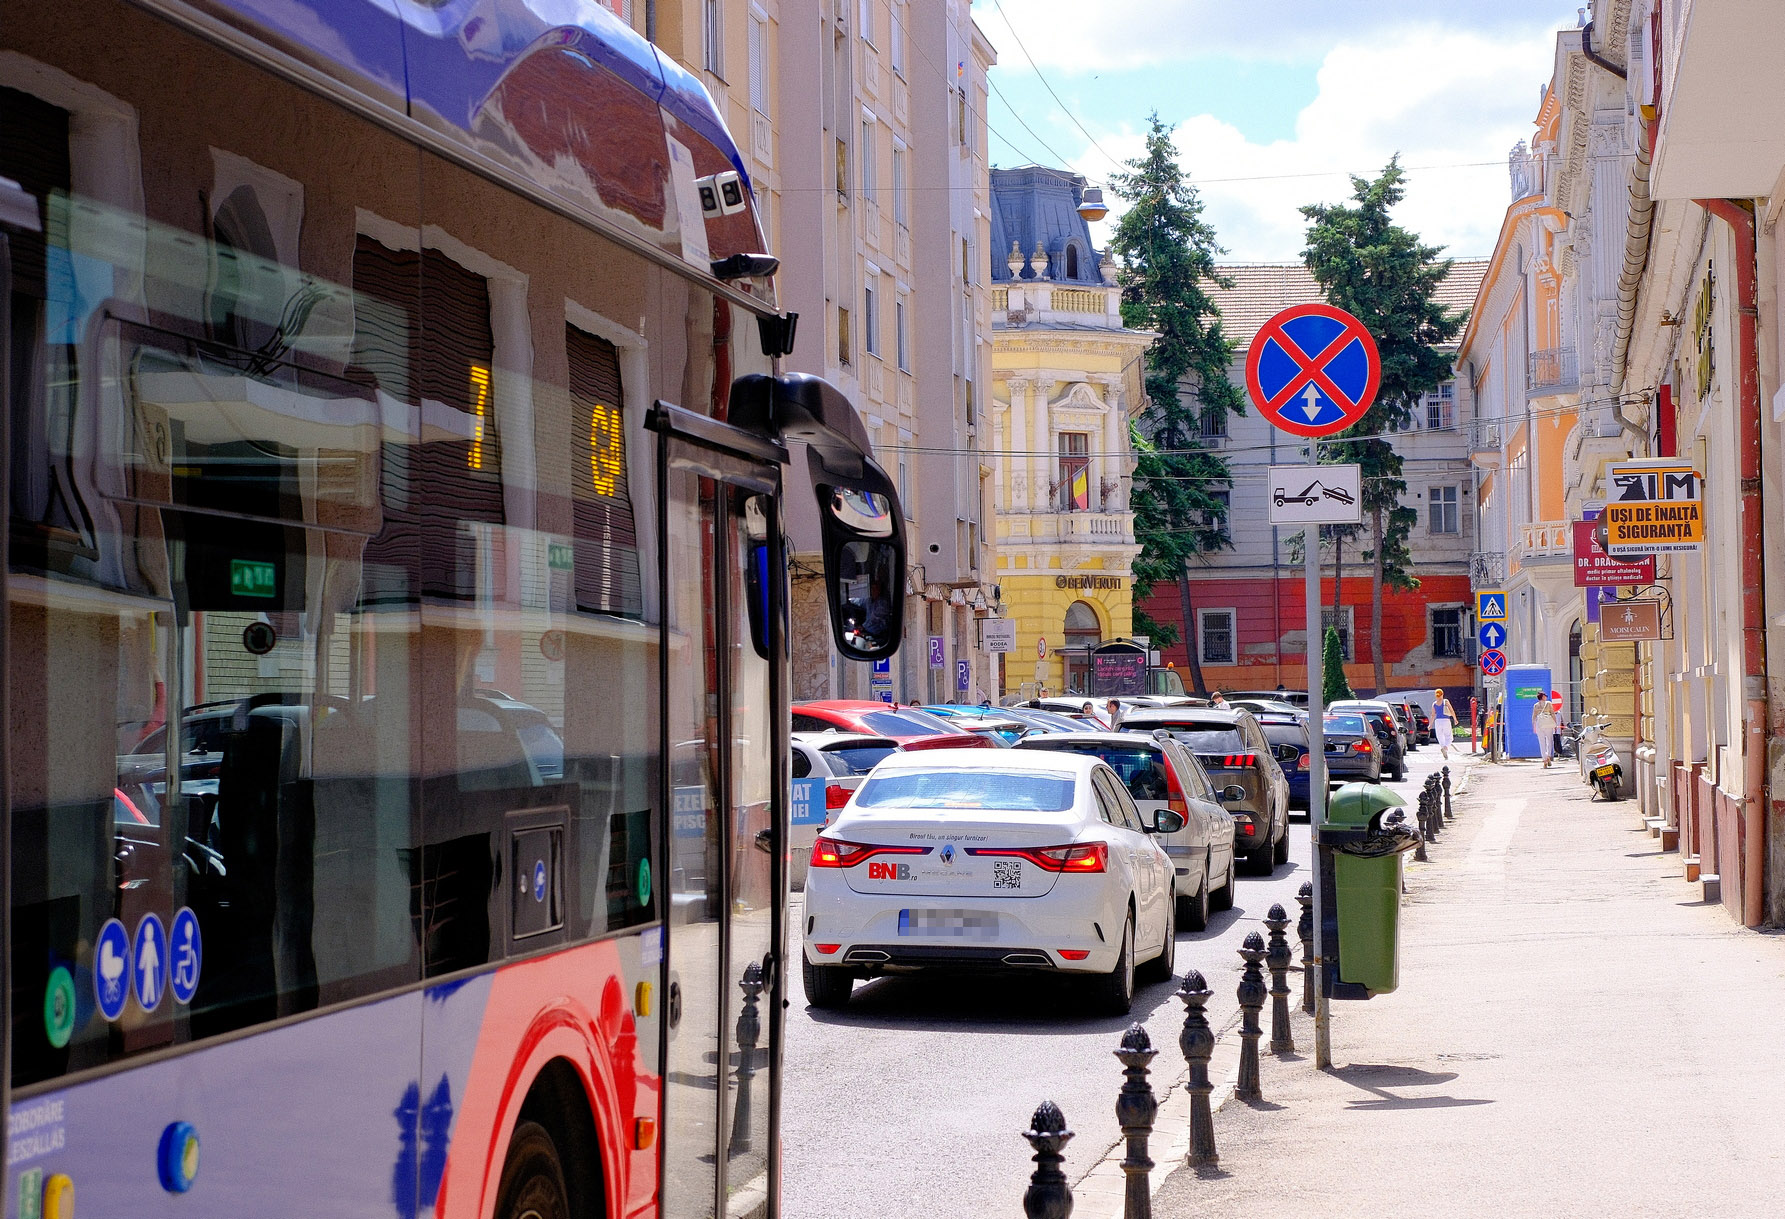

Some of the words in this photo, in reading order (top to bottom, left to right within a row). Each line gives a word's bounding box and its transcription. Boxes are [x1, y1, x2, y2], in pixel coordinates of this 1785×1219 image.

[467, 365, 489, 469] 7
[1636, 507, 1652, 522] DE
[1654, 503, 1699, 521] ÎNALTĂ
[1067, 575, 1121, 590] BENVENUTI
[930, 639, 939, 656] P
[958, 662, 966, 679] P
